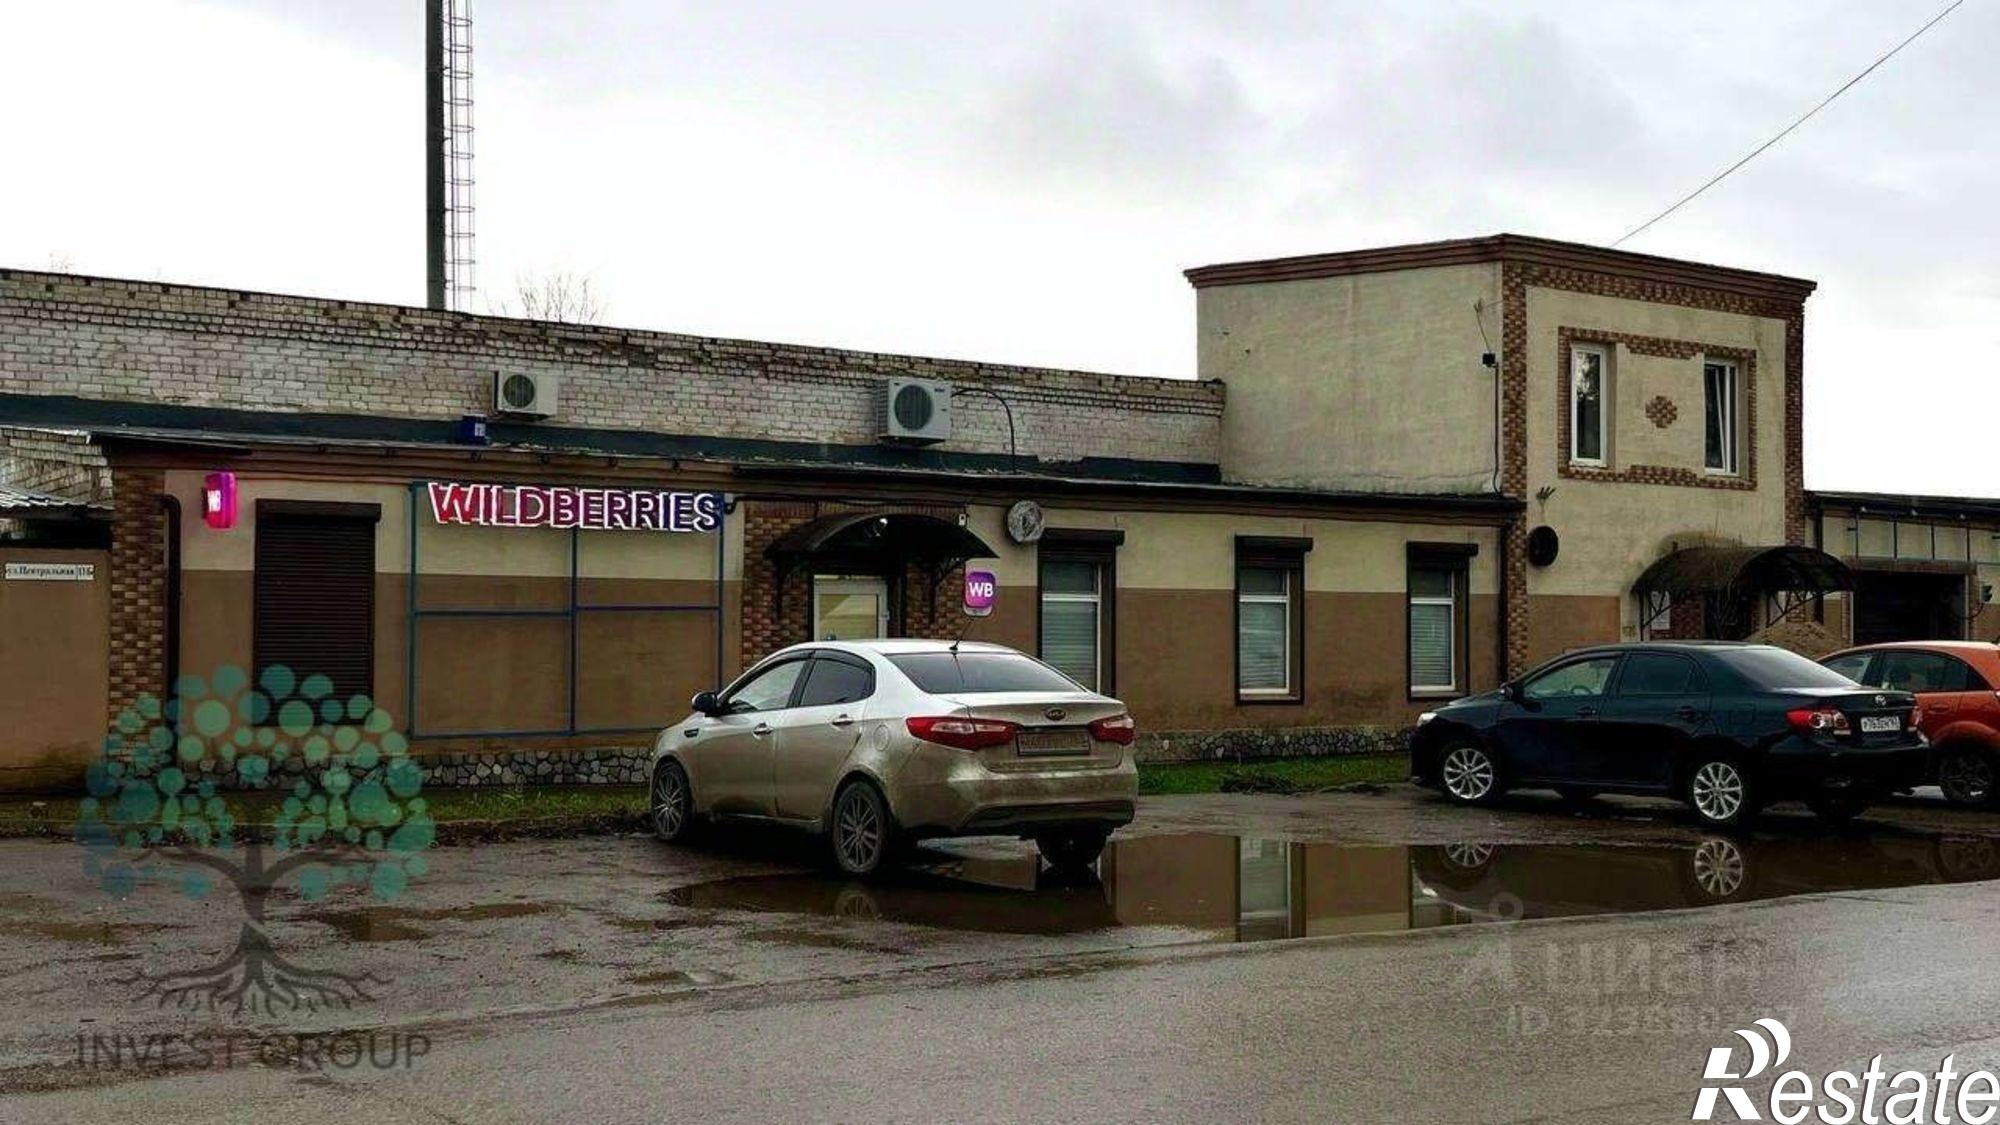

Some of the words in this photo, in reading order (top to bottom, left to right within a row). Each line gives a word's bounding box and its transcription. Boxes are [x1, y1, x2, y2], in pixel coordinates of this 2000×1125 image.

[207, 489, 222, 512] WB
[427, 482, 722, 533] WILDBERRIES
[968, 581, 994, 599] WB
